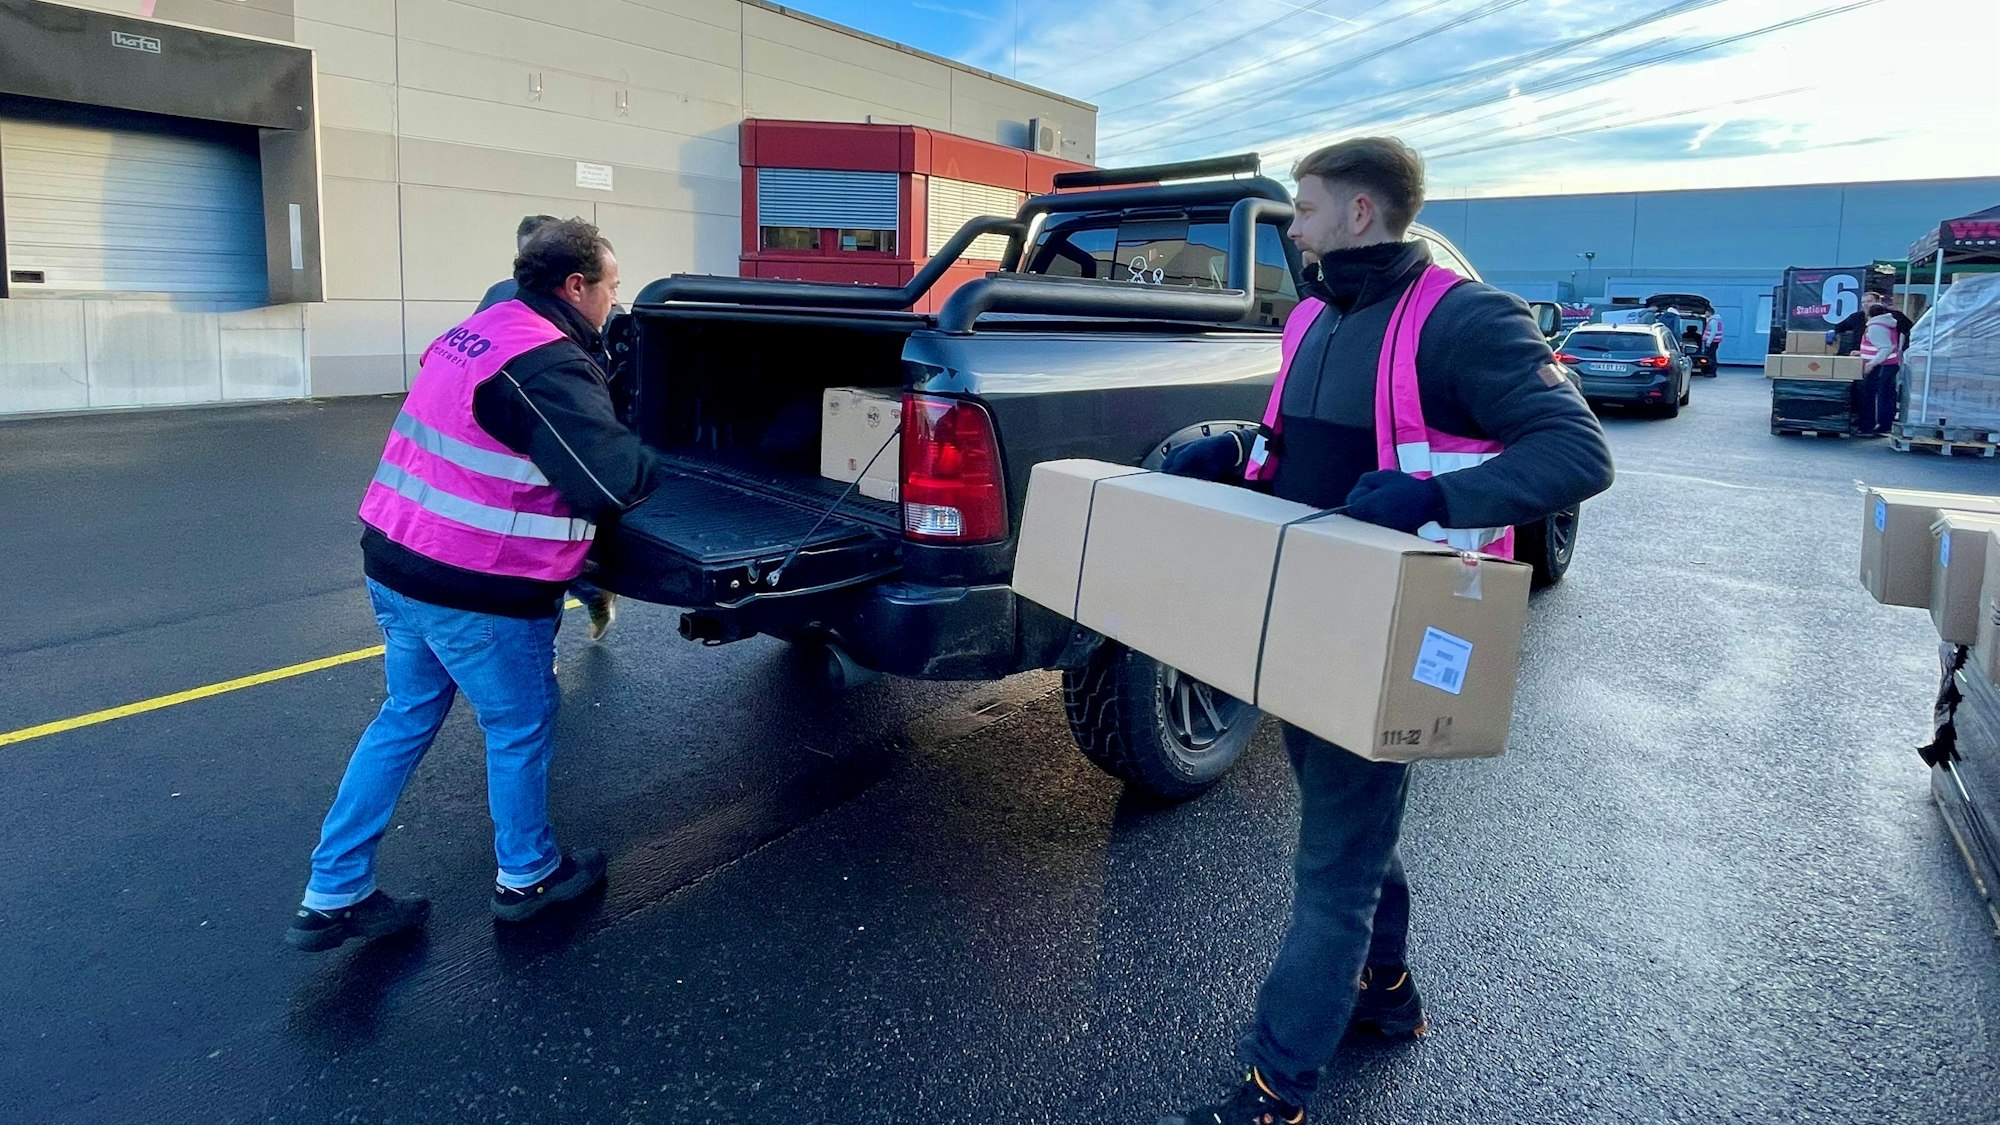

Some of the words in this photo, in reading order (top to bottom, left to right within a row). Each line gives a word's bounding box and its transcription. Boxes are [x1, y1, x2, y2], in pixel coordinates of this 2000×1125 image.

[116, 33, 157, 49] hafa
[1823, 275, 1859, 325] 6
[1796, 304, 1827, 315] Station
